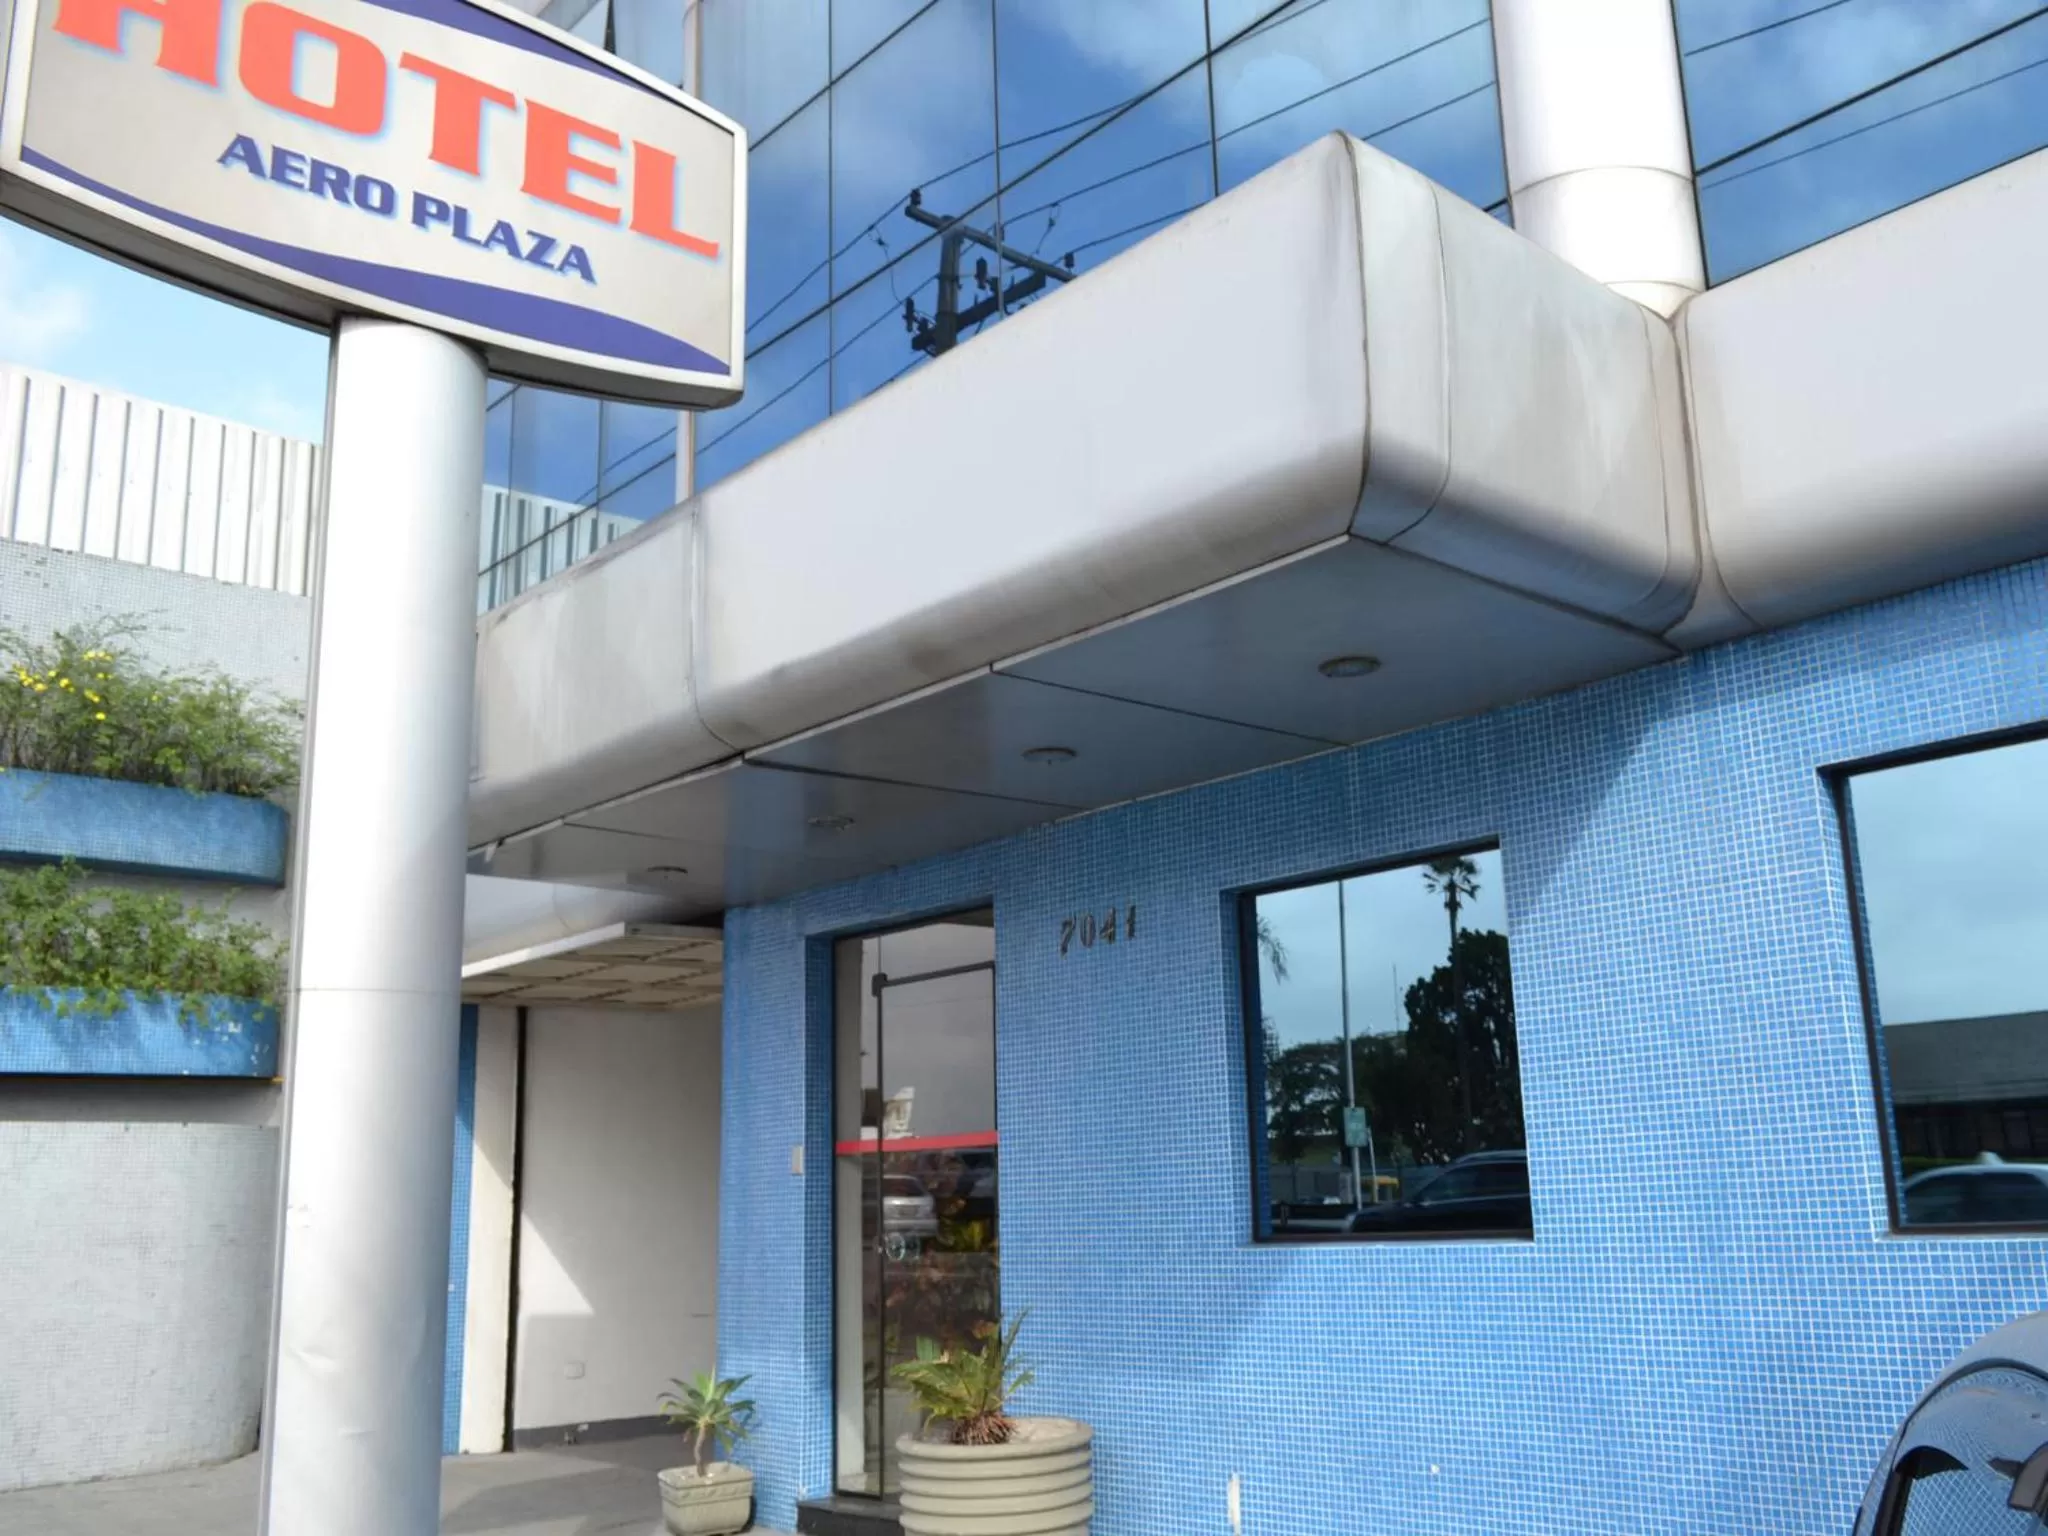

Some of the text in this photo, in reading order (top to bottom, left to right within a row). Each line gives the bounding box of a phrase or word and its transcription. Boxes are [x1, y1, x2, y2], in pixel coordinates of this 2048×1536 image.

[217, 133, 597, 284] AERO PLAZA
[1060, 904, 1136, 956] 7041
